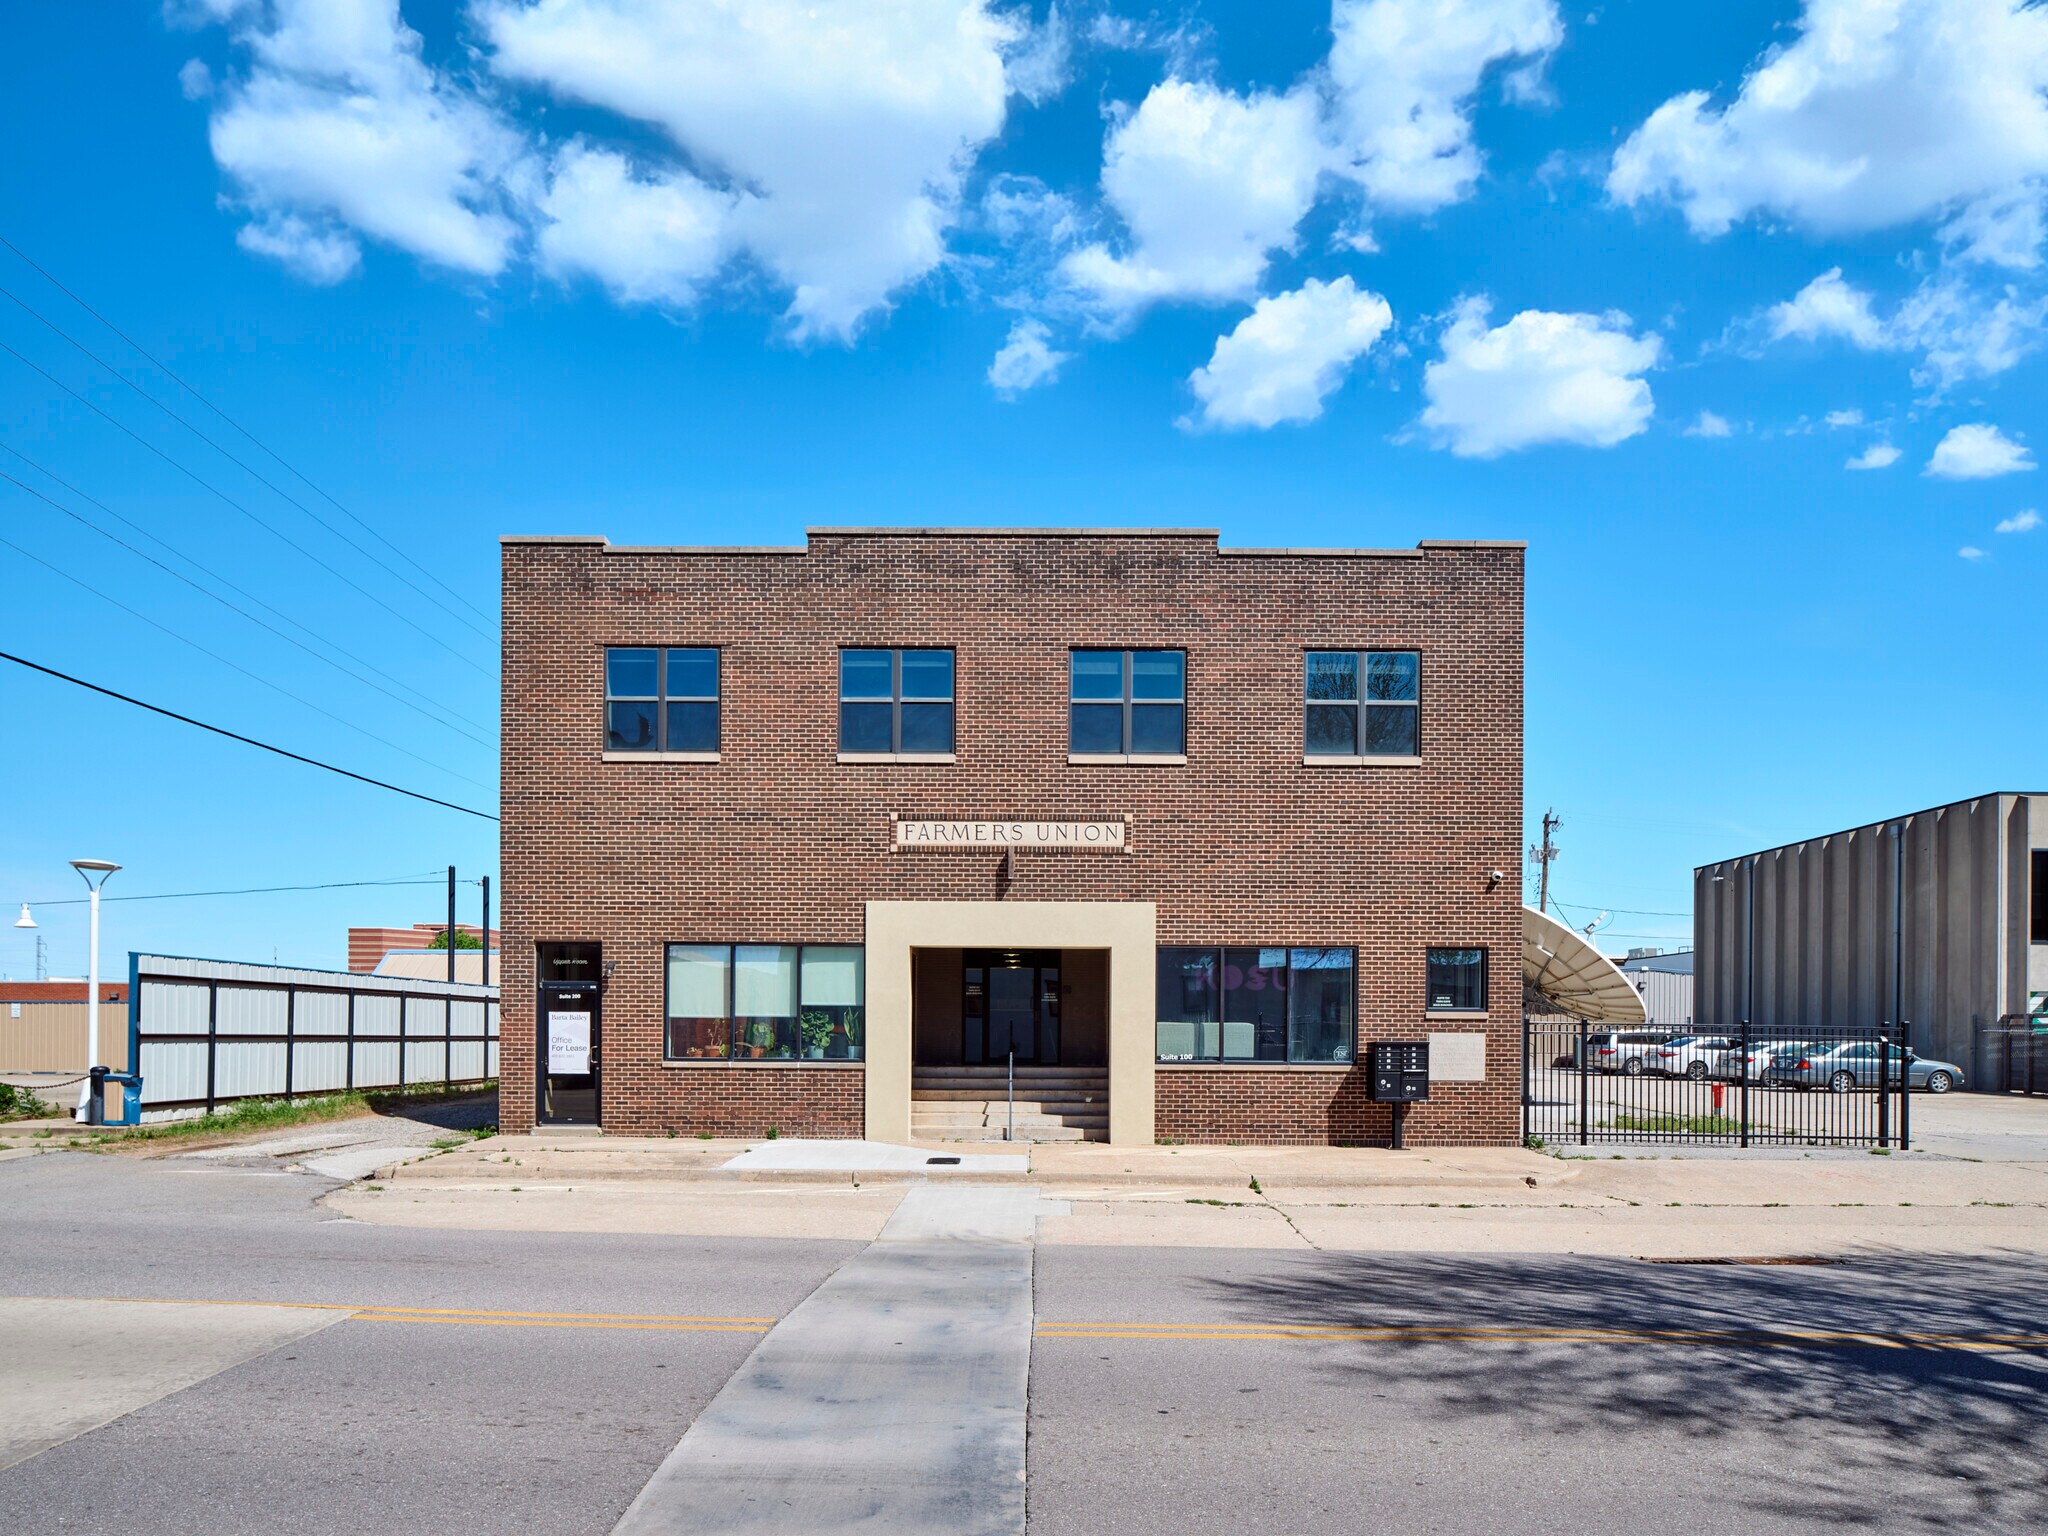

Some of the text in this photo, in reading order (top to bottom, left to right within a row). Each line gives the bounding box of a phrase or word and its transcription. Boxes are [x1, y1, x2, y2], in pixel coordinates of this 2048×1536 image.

[904, 824, 1118, 842] FARMERS UNION
[569, 1014, 587, 1022] Bailey
[551, 1036, 573, 1044] Office
[551, 1044, 588, 1052] For Lease
[1160, 1053, 1179, 1061] Suite
